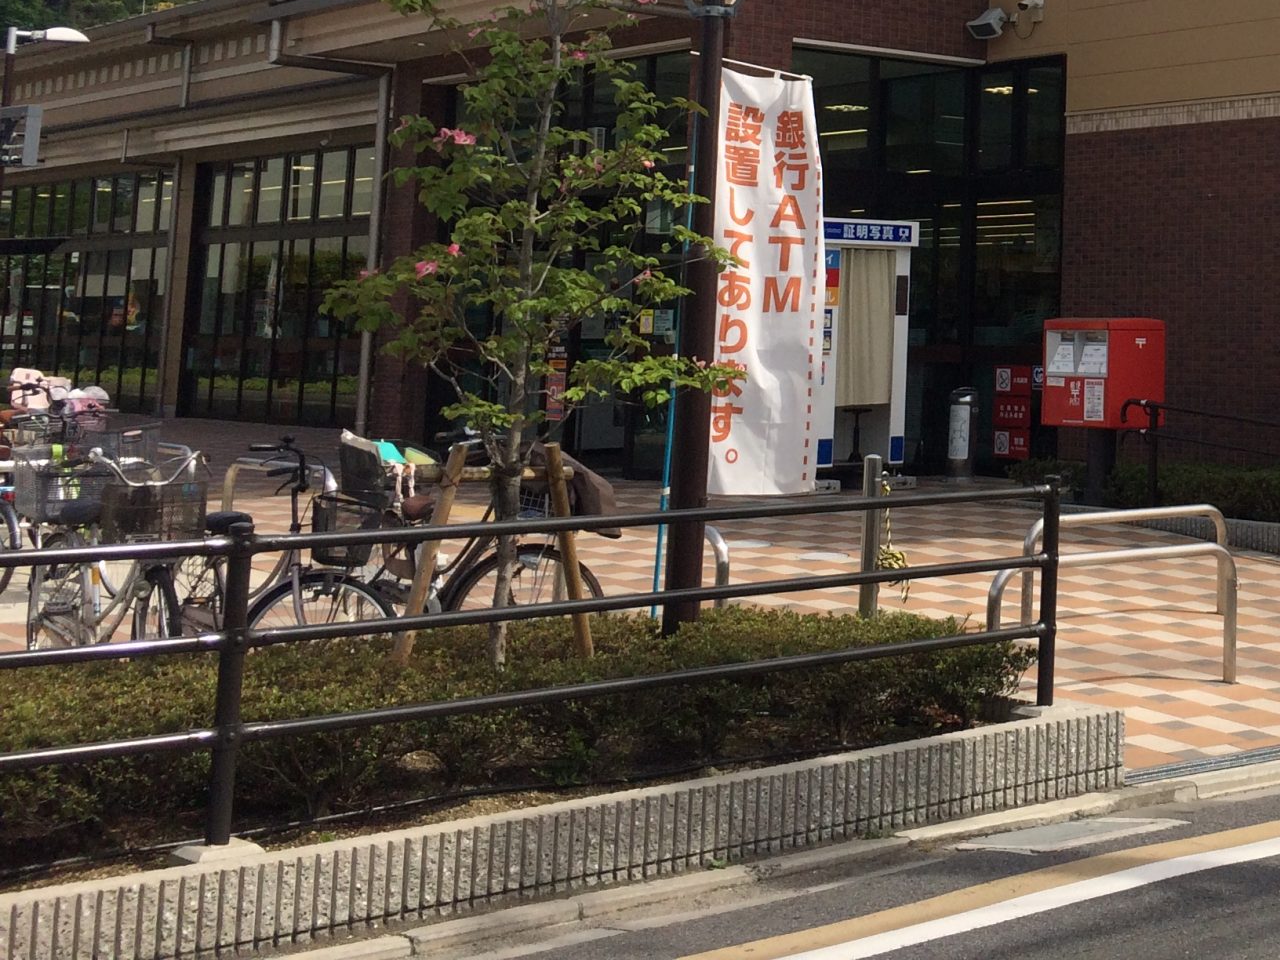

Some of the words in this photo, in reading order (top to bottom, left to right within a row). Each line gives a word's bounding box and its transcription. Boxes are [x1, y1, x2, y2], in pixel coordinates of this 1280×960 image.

[762, 109, 809, 313] 銀行ATM
[843, 224, 894, 239] 証明写真
